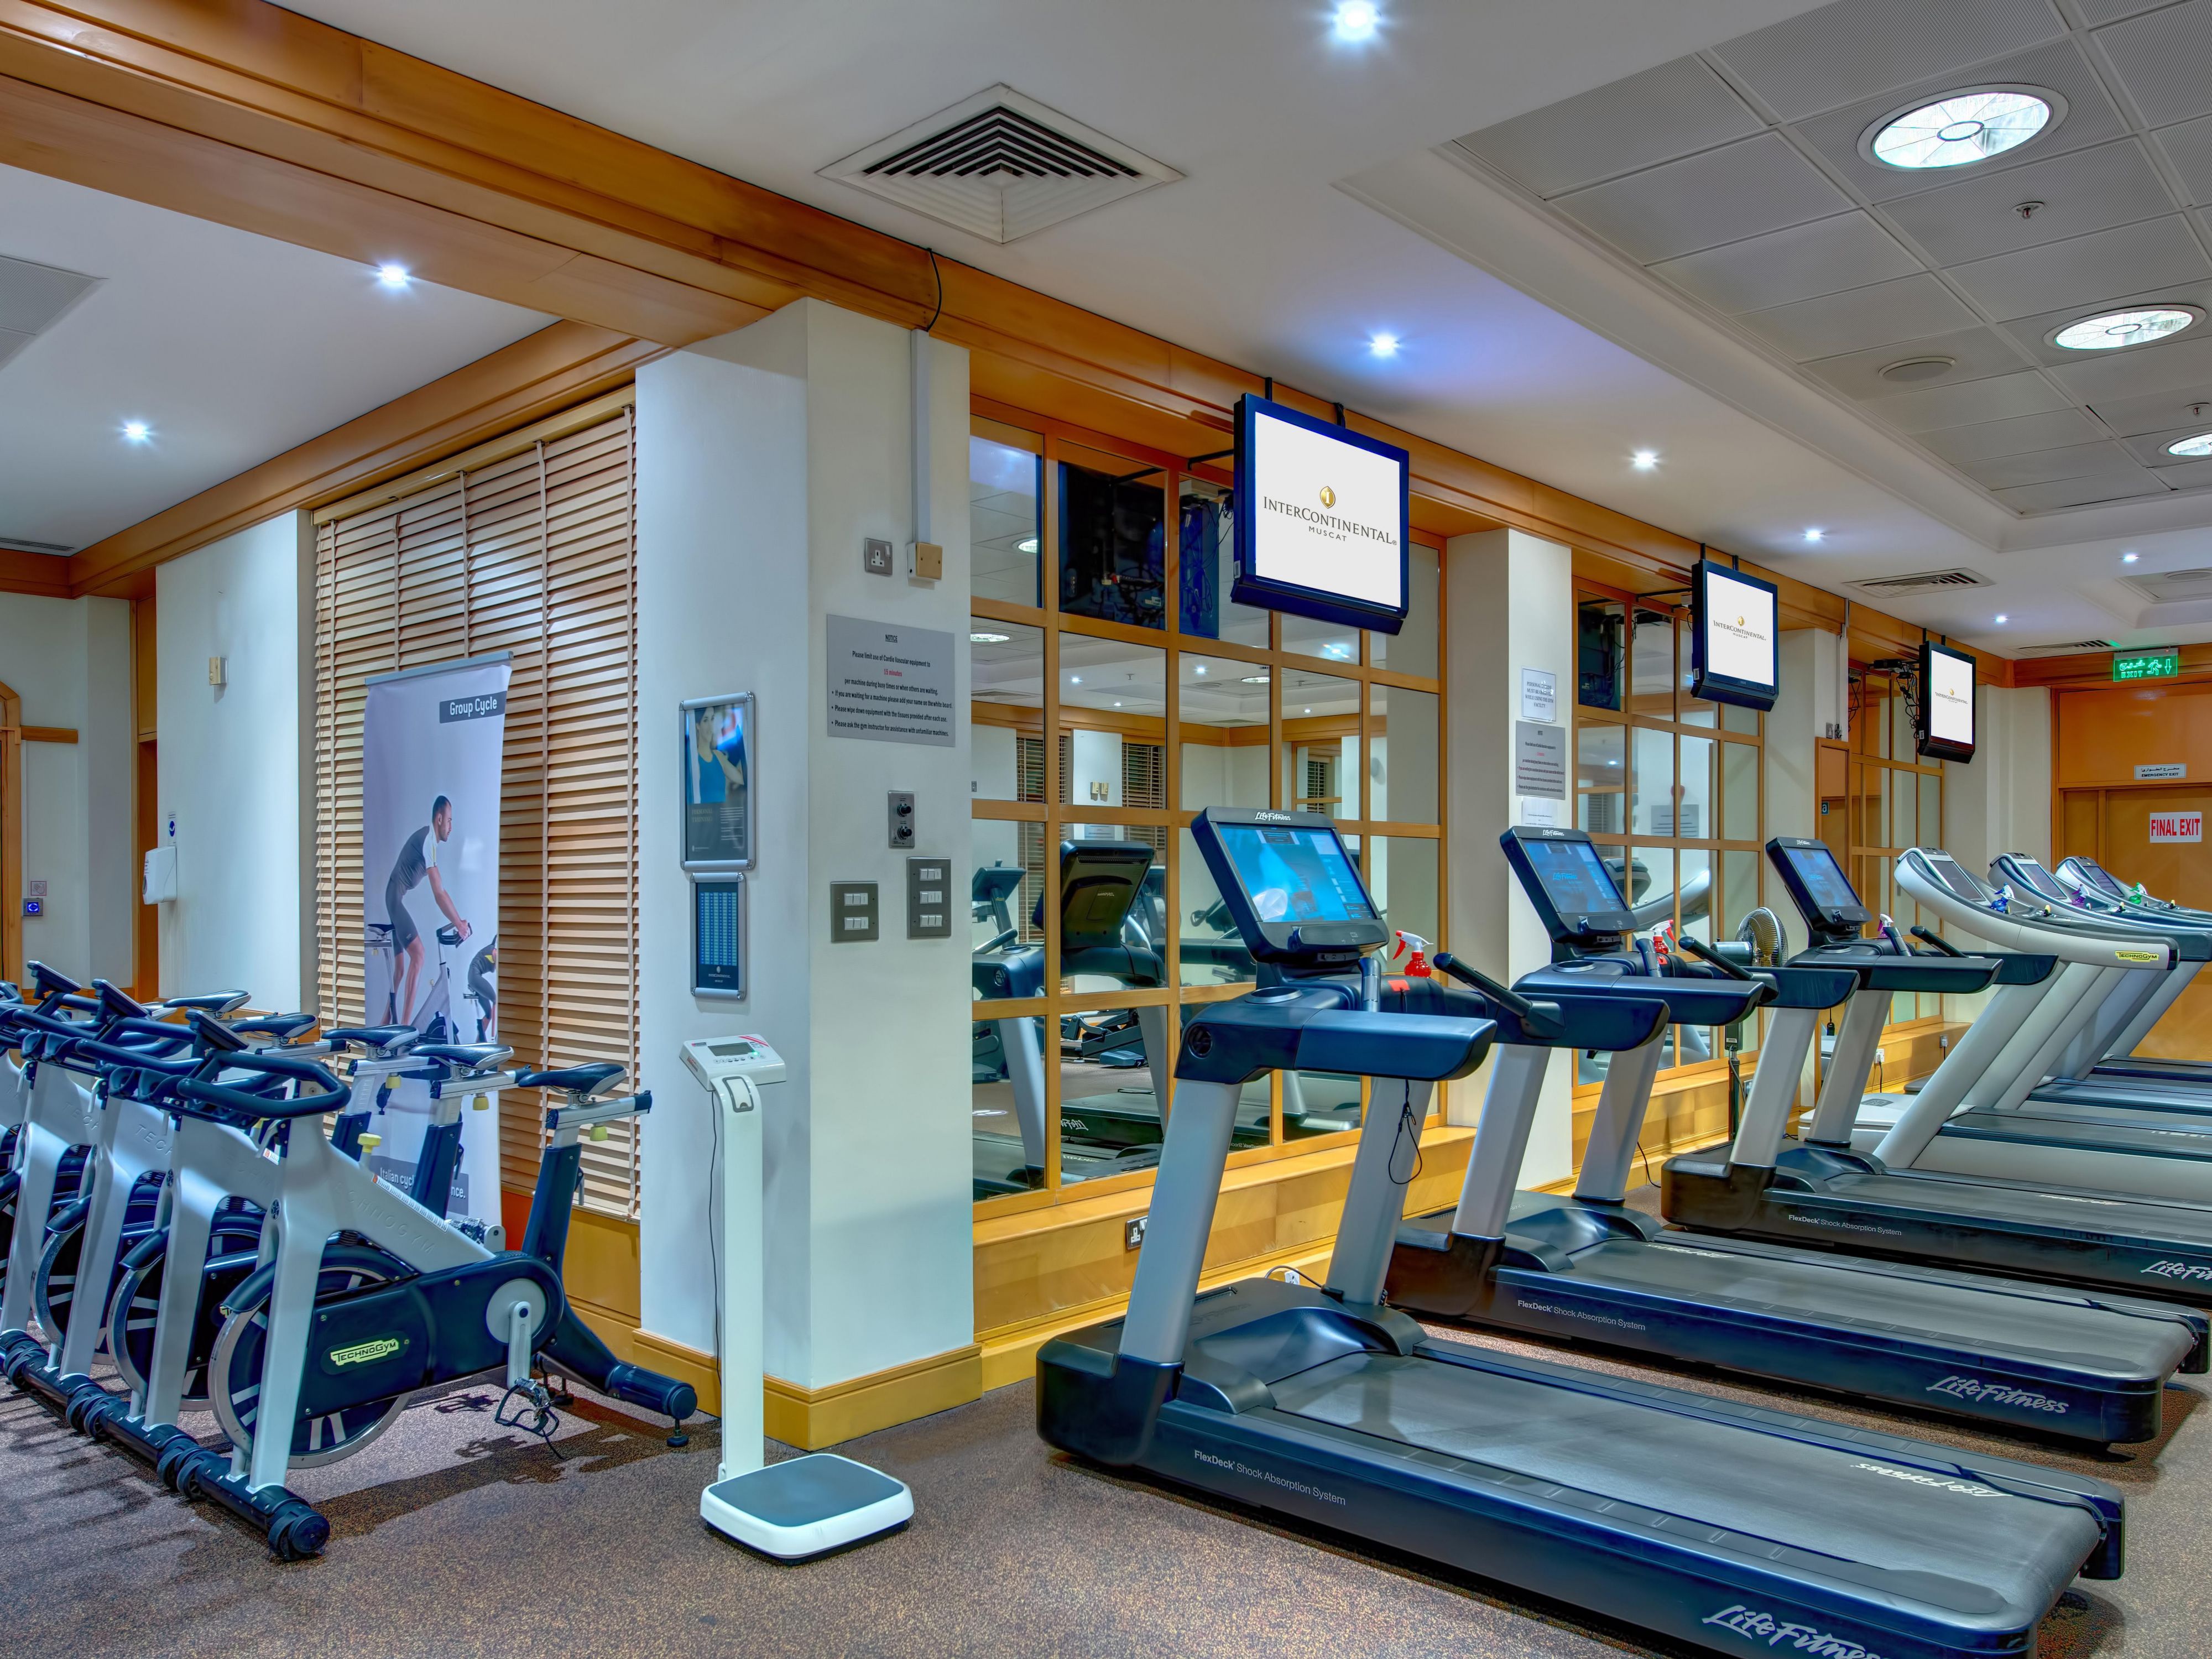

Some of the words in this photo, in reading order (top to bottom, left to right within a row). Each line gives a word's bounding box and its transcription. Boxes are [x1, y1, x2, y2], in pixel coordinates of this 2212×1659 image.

[1309, 526, 1347, 541] MUSCAT
[885, 634, 898, 643] NOTICE
[866, 680, 877, 688] during
[450, 702, 473, 717] Group
[475, 696, 497, 716] Cycle
[2151, 819, 2177, 836] FINAL
[2179, 818, 2200, 836] EXIT
[380, 1167, 398, 1183] Italian
[400, 1173, 414, 1189] cycl
[1821, 1219, 1840, 1227] Shock
[1841, 1223, 1876, 1232] Absorption
[1877, 1227, 1902, 1236] System
[1554, 1307, 1575, 1318] Shock
[1577, 1311, 1616, 1325] Absorption
[1618, 1319, 1646, 1331] System
[1237, 1463, 1262, 1479] Shock
[1264, 1471, 1311, 1495] Absorption
[1313, 1486, 1346, 1506] System
